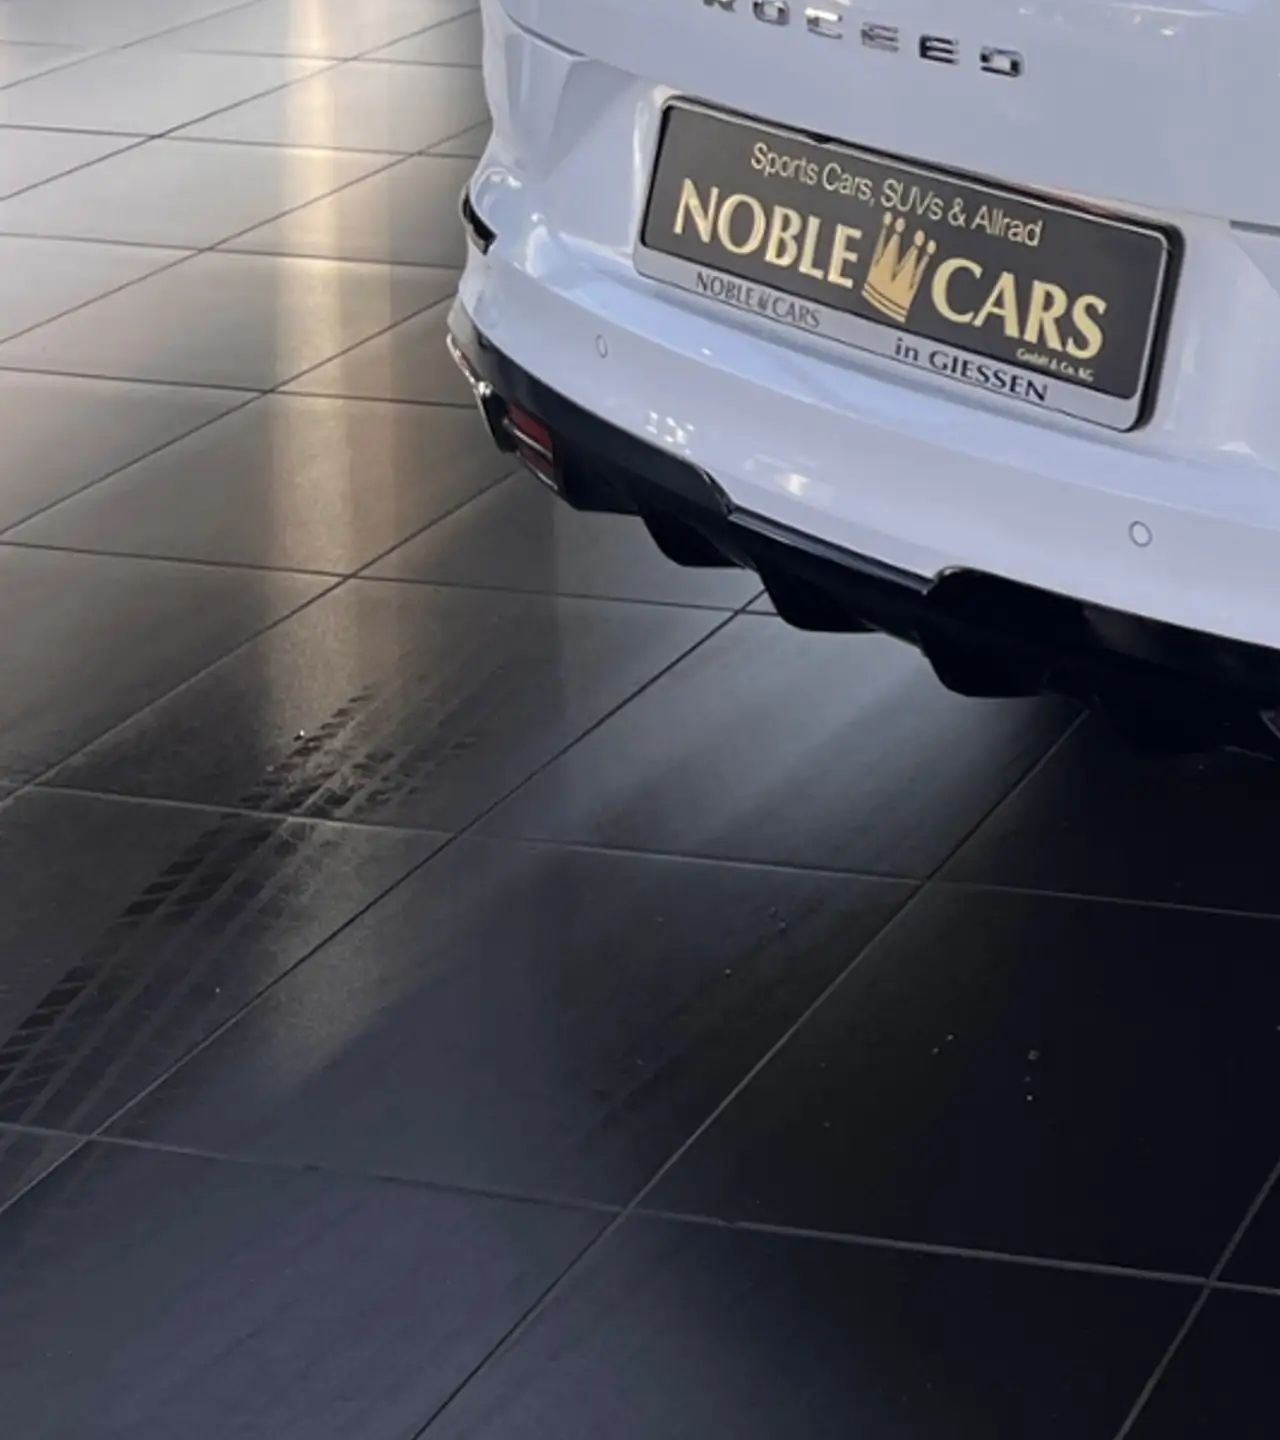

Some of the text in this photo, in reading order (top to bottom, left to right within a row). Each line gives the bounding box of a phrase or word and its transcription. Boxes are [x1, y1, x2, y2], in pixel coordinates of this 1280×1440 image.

[751, 142, 1044, 248] Sports Cars, SUVs & Allrad
[673, 177, 1108, 360] NOBLE CARS
[695, 270, 821, 330] NOBLE CARS
[894, 337, 1049, 403] in GIESSEN
